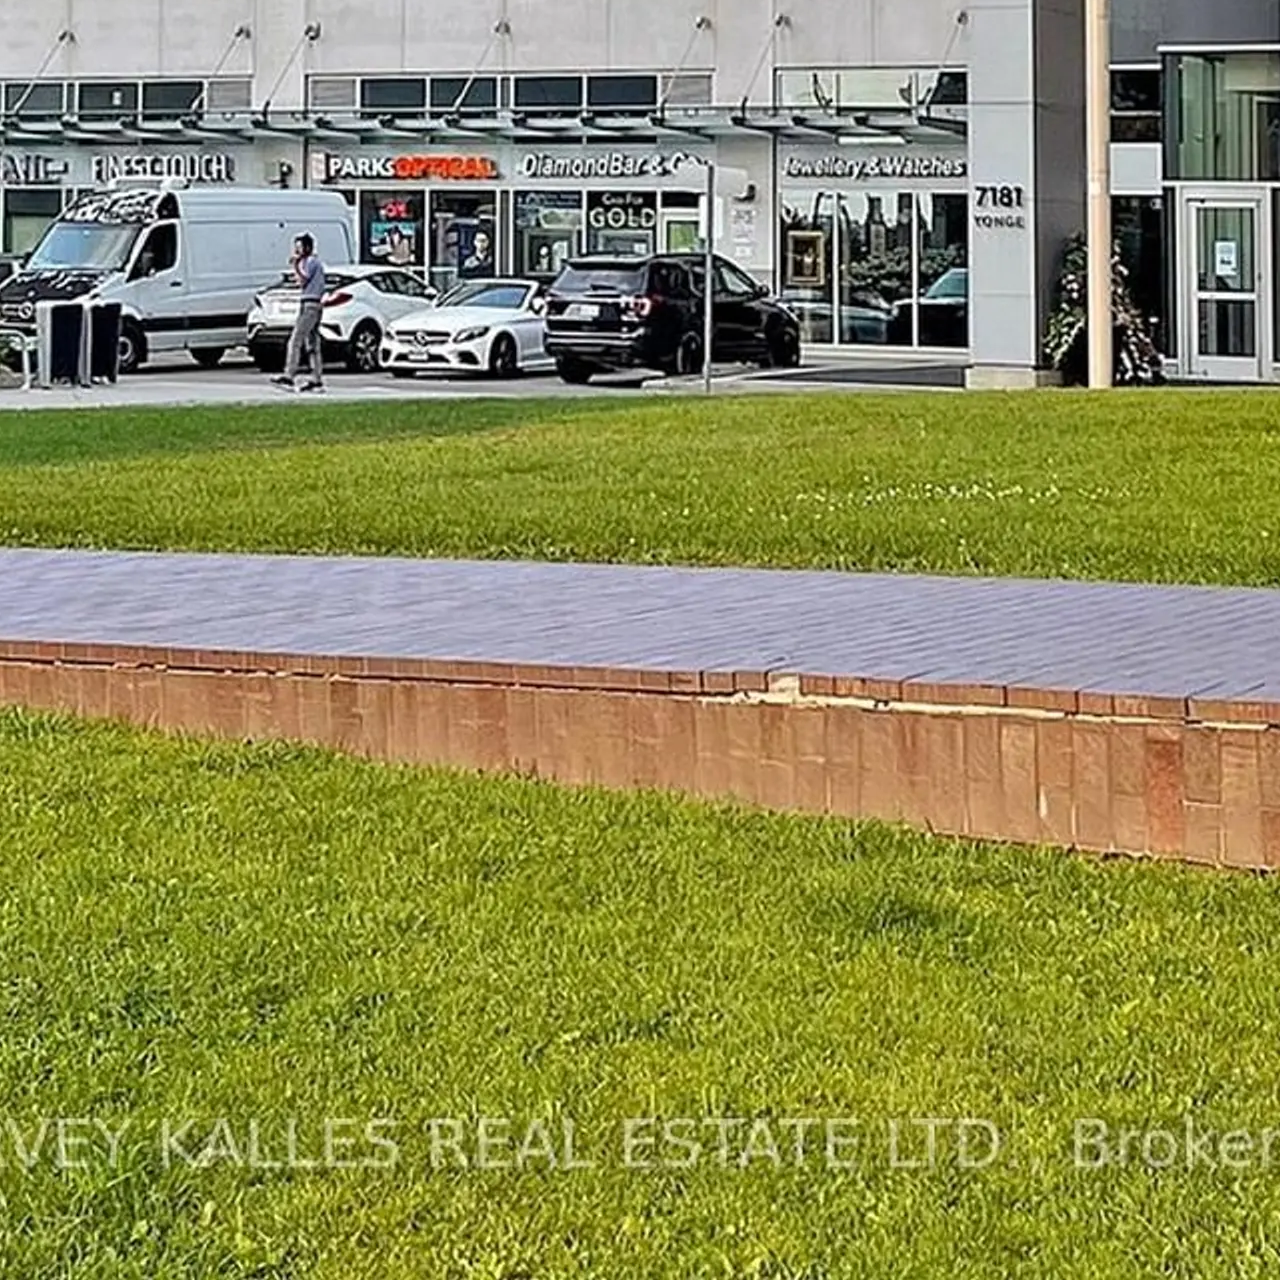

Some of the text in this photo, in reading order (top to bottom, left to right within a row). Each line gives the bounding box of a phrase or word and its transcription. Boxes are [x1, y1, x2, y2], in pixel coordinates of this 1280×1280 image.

[974, 186, 1024, 208] 7181
[589, 207, 656, 228] GOLD
[973, 214, 1025, 229] YONGE
